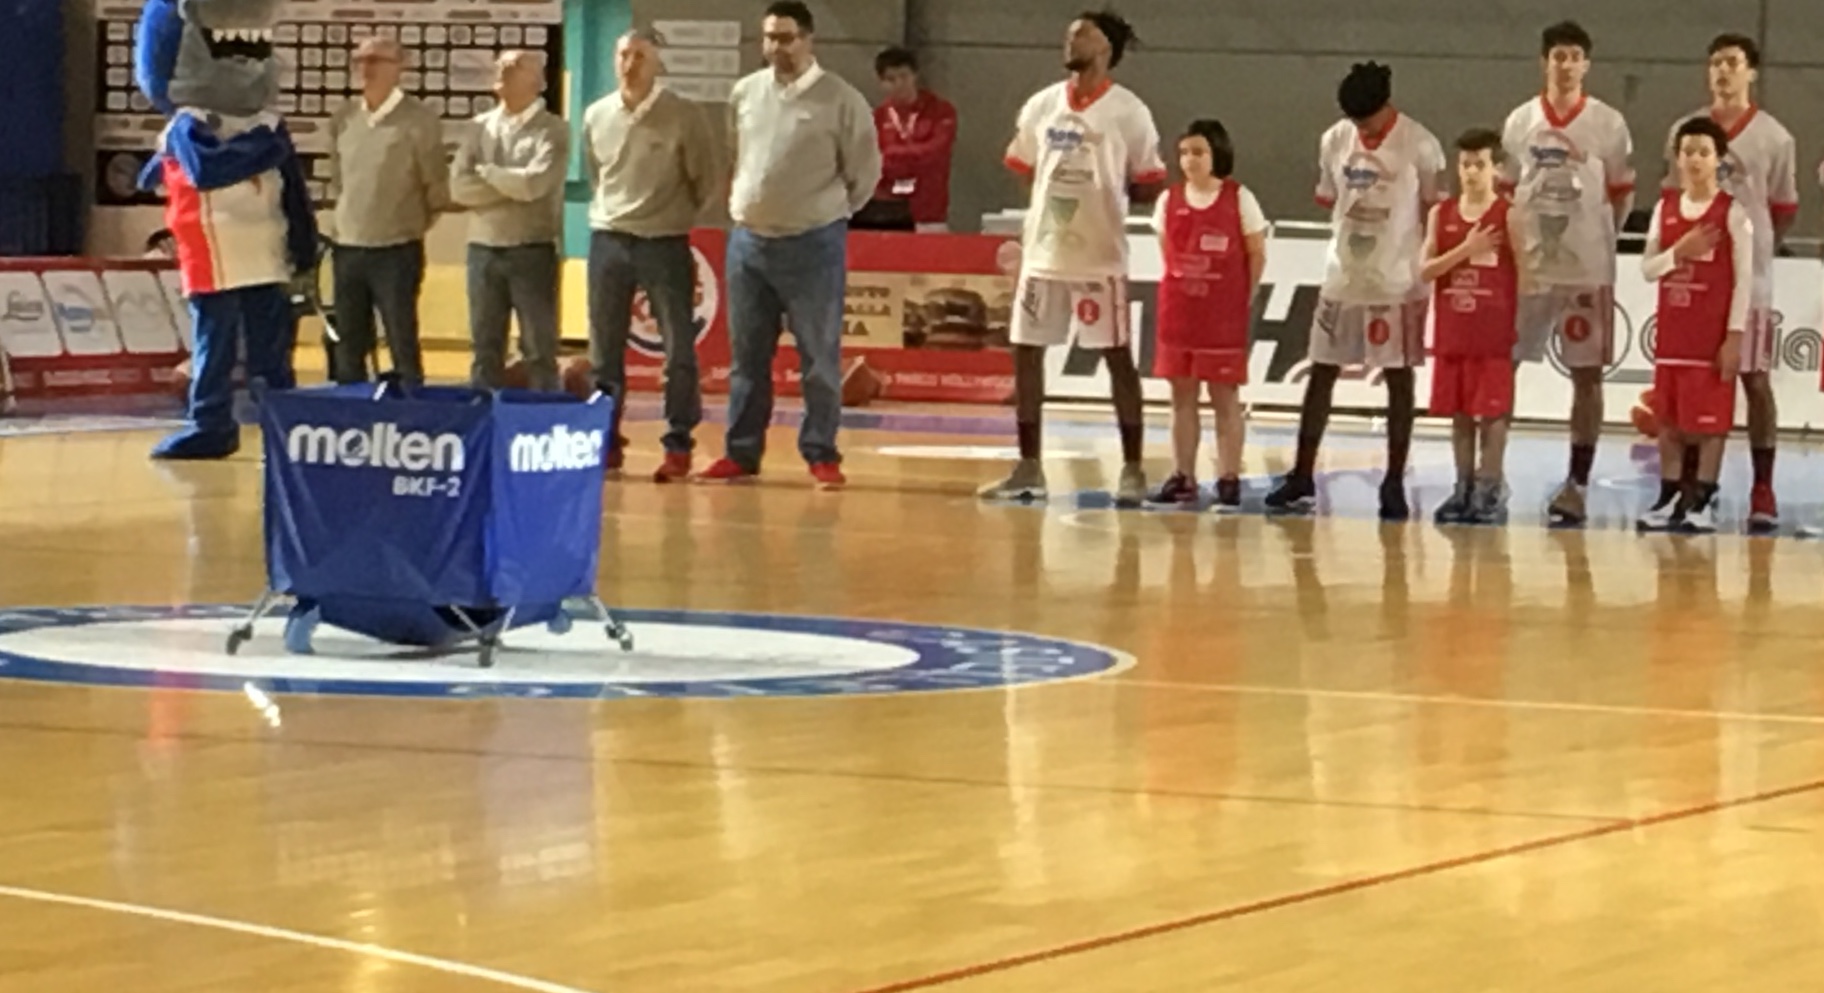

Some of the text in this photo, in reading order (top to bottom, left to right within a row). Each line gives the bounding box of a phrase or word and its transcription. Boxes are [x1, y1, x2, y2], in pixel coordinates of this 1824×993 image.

[288, 422, 466, 470] molten
[510, 426, 604, 472] molten
[393, 475, 461, 497] BKF-2
